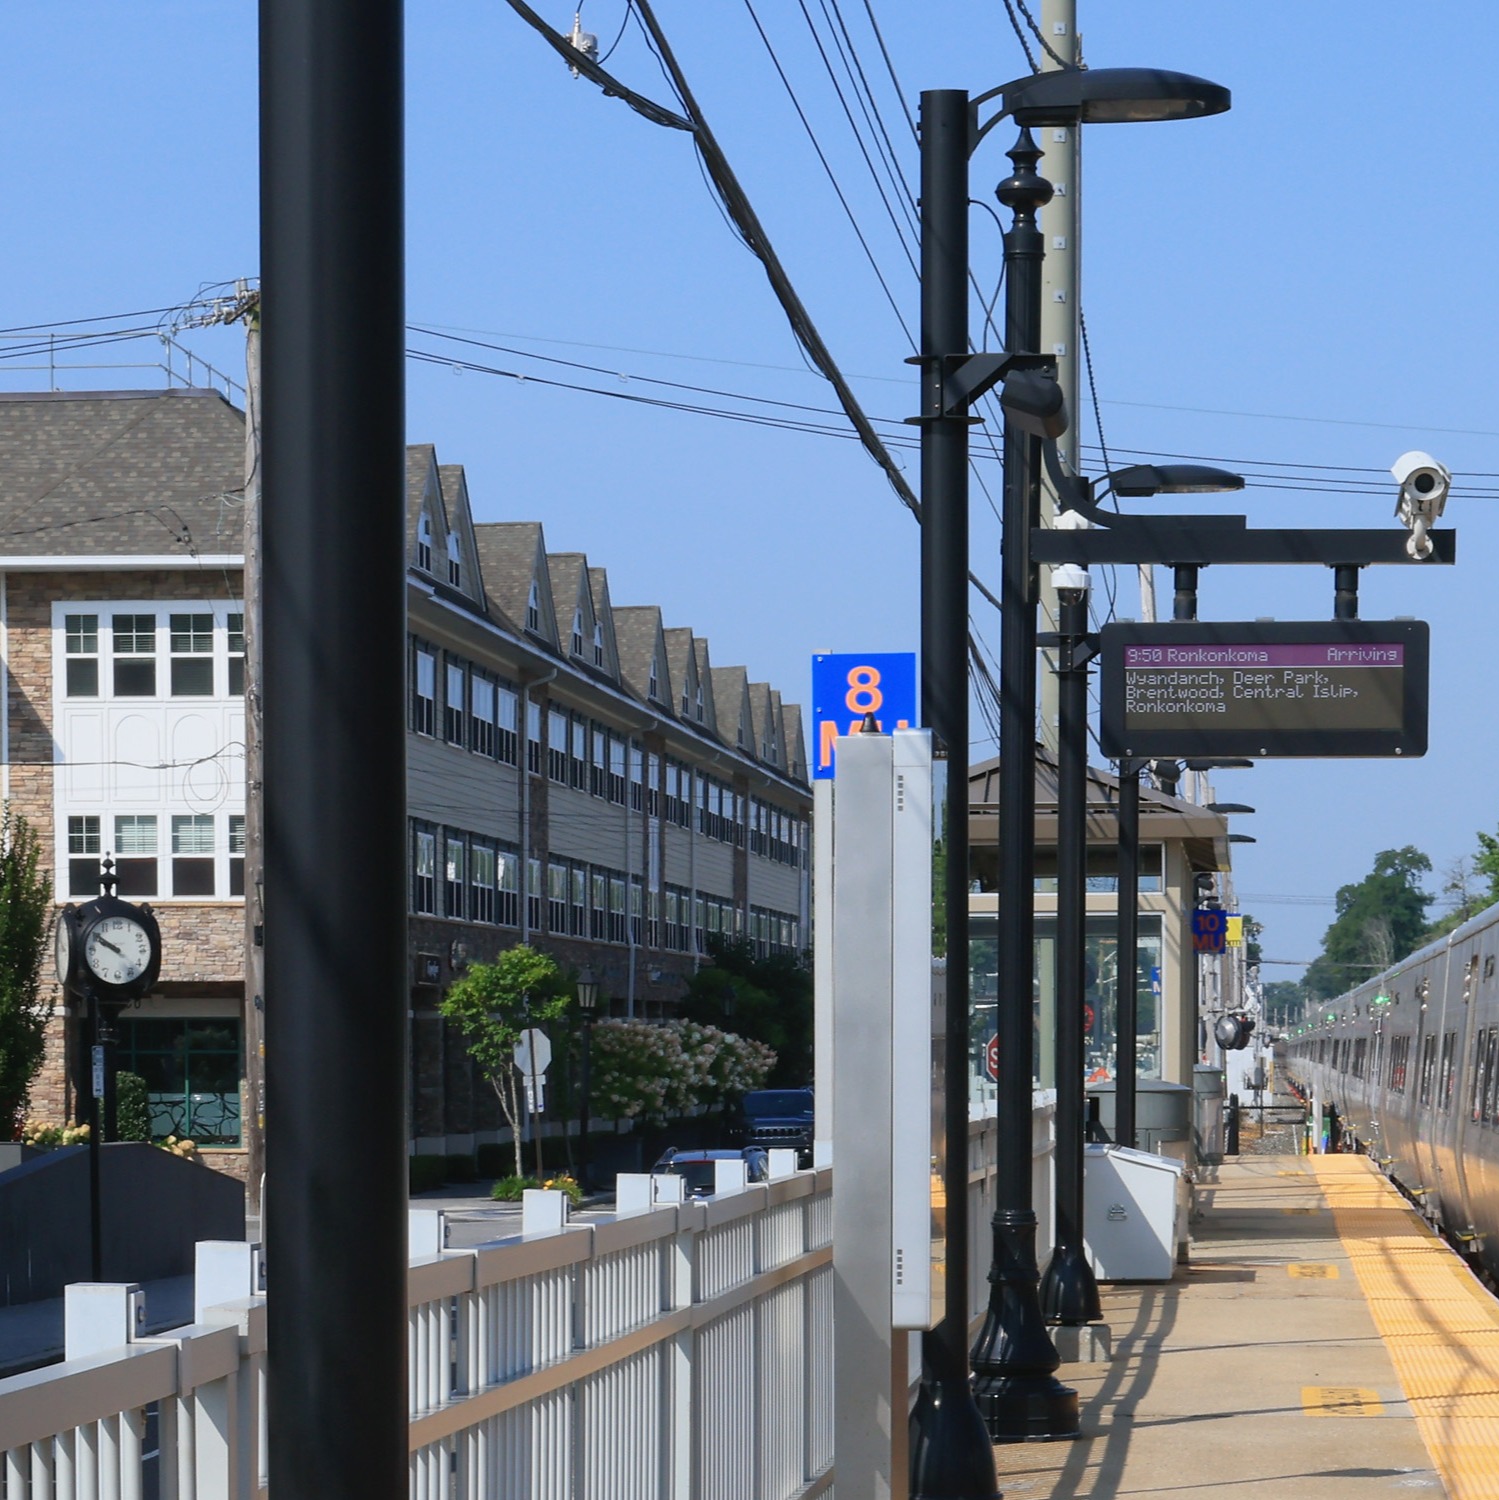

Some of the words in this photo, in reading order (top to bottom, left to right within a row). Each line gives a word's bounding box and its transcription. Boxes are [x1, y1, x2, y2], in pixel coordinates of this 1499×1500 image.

[1127, 648, 1163, 663] 9:50
[1167, 648, 1269, 663] Ronkonkoma
[1327, 647, 1398, 662] Arriving
[1125, 671, 1225, 685] Wyandanch,
[1233, 671, 1275, 685] Deer
[1283, 670, 1329, 685] Park,
[845, 665, 883, 714] 8
[1125, 685, 1225, 699] Brentwood,
[1233, 684, 1304, 699] Central
[1312, 684, 1359, 698] Islip,
[1125, 699, 1226, 713] Ronkonkoma
[1198, 914, 1219, 931] 10
